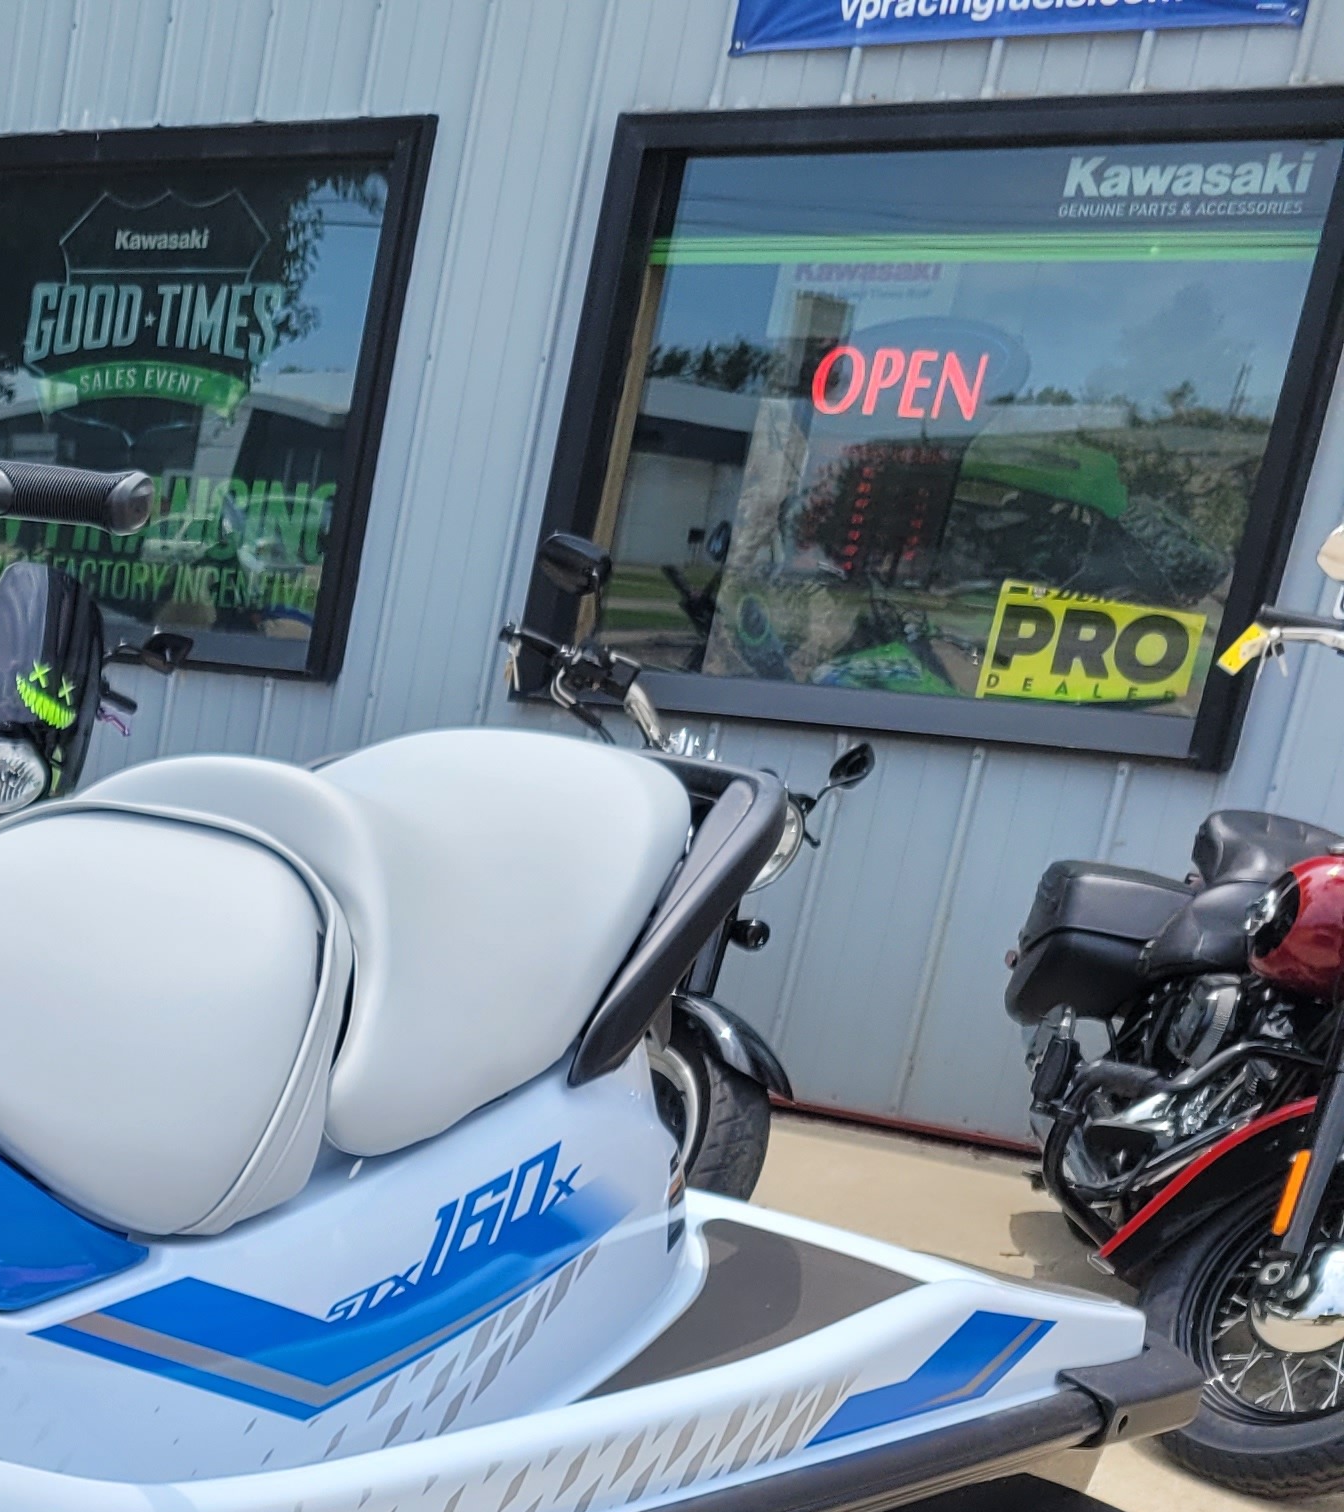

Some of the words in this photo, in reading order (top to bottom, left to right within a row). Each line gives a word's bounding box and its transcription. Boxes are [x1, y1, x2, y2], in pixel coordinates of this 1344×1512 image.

[1063, 152, 1317, 198] Kawasaki
[1058, 201, 1127, 218] GENUINE
[1128, 201, 1177, 217] PARTS
[1180, 201, 1192, 215] &
[1194, 200, 1304, 216] ACCESSORIES
[115, 228, 210, 250] Kawasaki
[23, 282, 143, 365] GOOD
[157, 283, 285, 366] TIMES
[80, 367, 137, 394] SALES
[144, 368, 204, 396] EVENT
[812, 345, 990, 421] OPEN
[991, 603, 1190, 685] PRO
